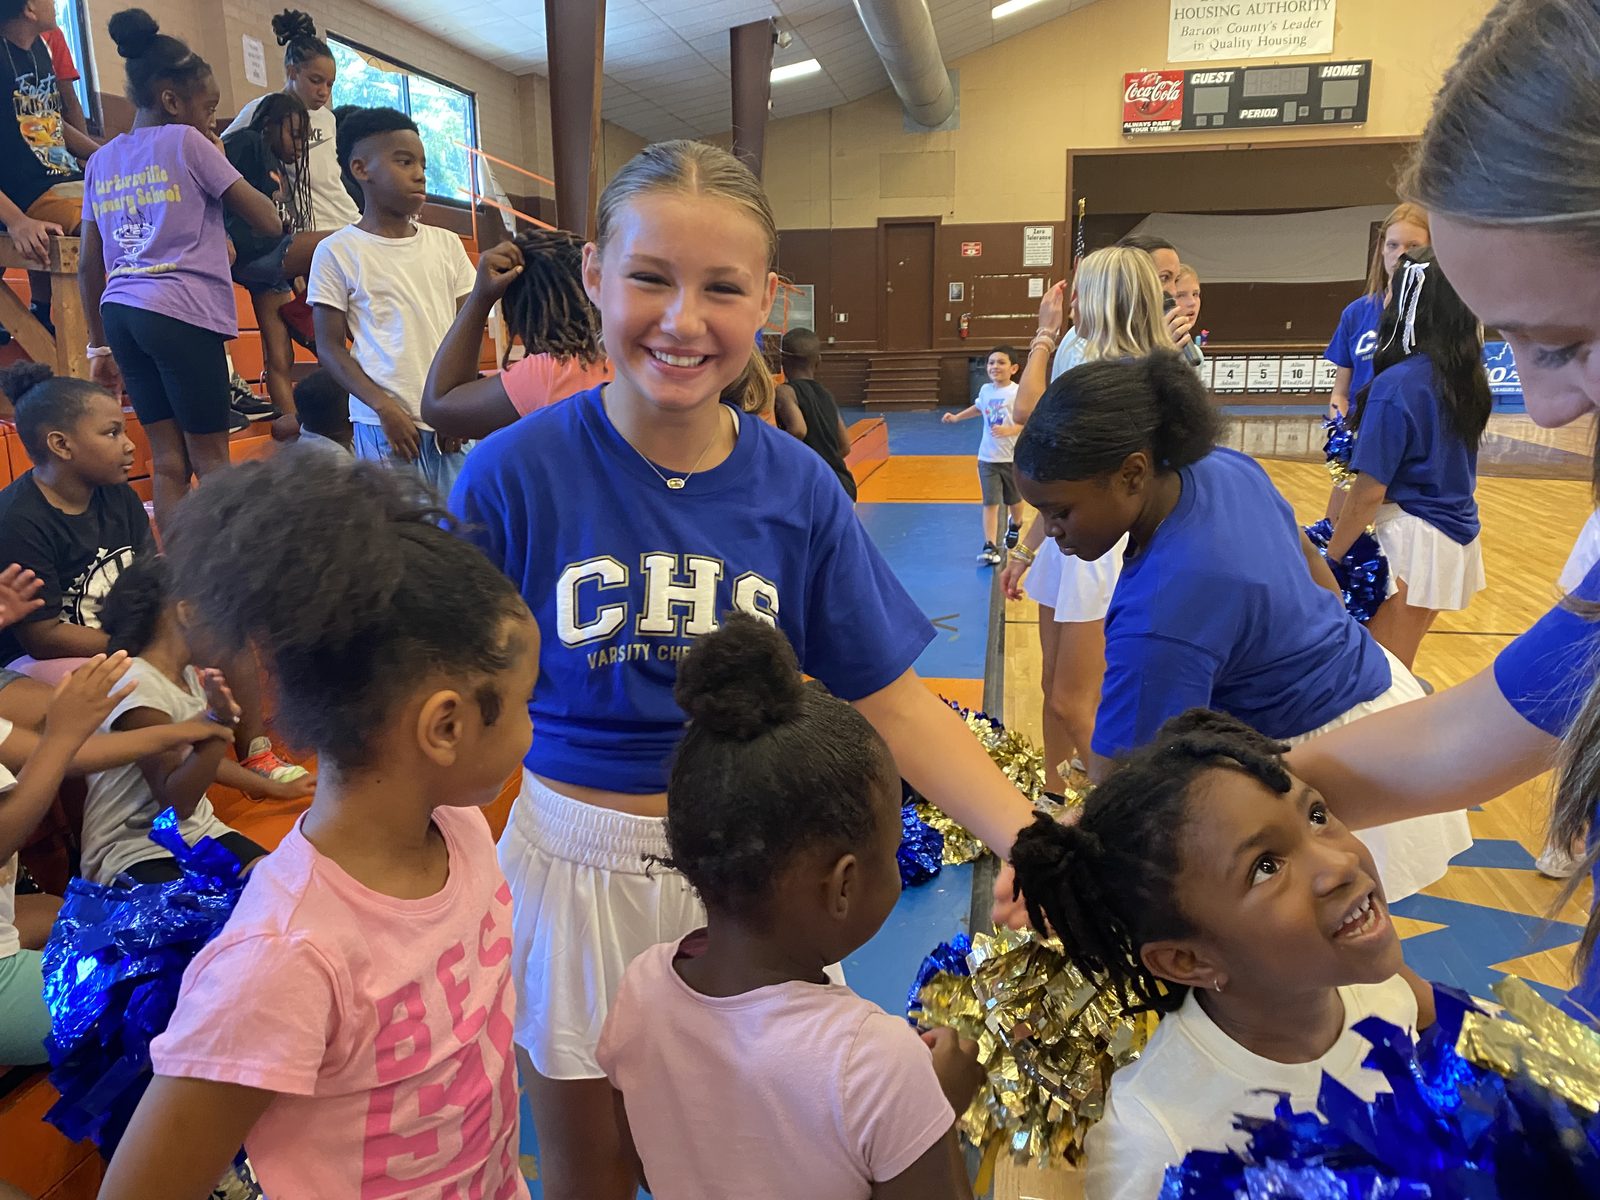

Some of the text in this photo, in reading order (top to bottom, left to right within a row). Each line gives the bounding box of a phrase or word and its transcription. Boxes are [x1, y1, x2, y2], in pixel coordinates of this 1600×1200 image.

[1174, 0, 1331, 20] HOUSING AUTHORITY
[1226, 20, 1278, 34] County's
[1282, 17, 1323, 31] Leader
[1193, 34, 1308, 51] in Quality Housing
[1190, 71, 1234, 85] GUEST
[1320, 64, 1362, 78] HOME
[1239, 108, 1279, 119] PERIOD
[1227, 369, 1234, 379] 4
[1260, 368, 1267, 379] 5
[1292, 368, 1303, 379] 10
[1325, 368, 1337, 378] 12
[556, 551, 779, 649] CHS
[587, 643, 691, 670] VARSITY CHE
